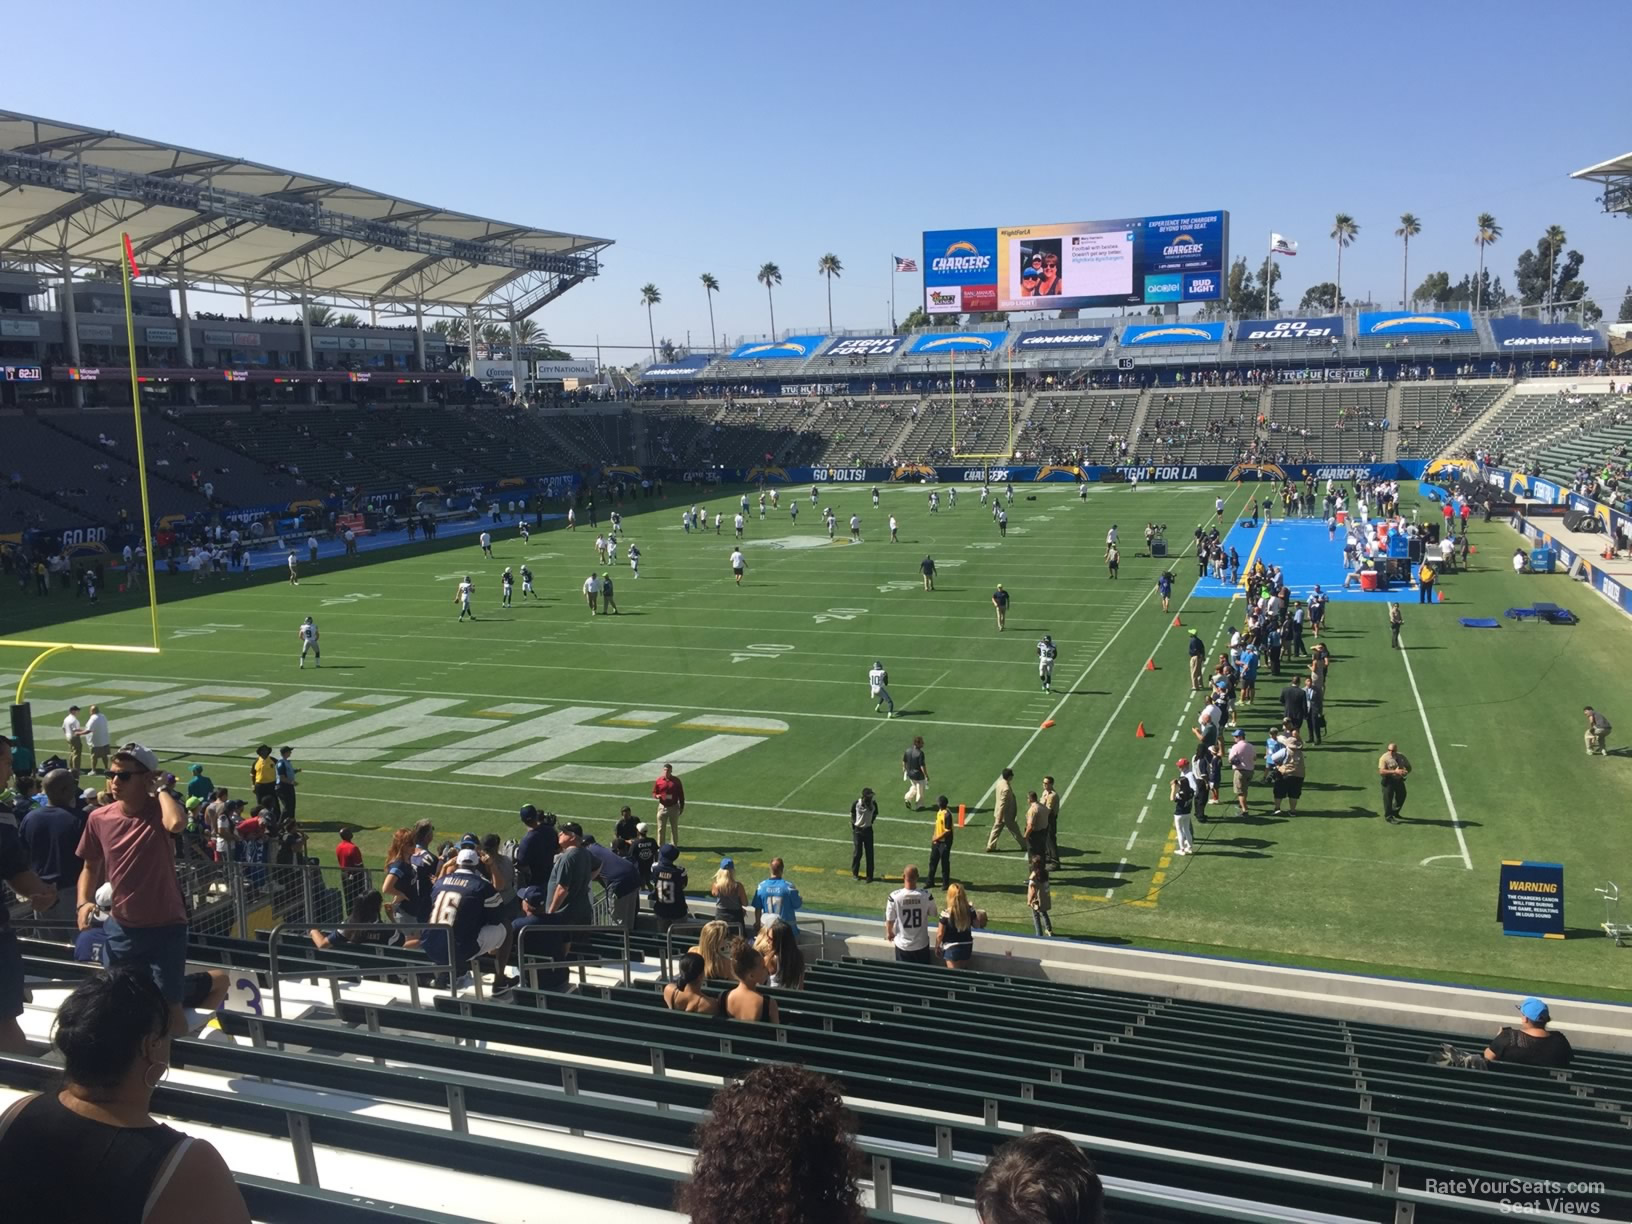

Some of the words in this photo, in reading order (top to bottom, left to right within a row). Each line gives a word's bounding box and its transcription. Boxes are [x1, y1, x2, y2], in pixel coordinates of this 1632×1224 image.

[1163, 243, 1203, 255] CHARGERS
[932, 255, 991, 271] CHARGERS
[1193, 279, 1211, 287] BUD
[1189, 285, 1215, 293] LIGHT
[1274, 321, 1307, 330] GO
[1248, 328, 1331, 339] BOLTS!
[839, 338, 900, 347] FIGHT
[1503, 336, 1594, 346] CHARGERS
[828, 346, 868, 355] FOR
[869, 346, 894, 354] LA
[539, 365, 553, 373] CITY
[554, 365, 590, 373] NATIONAL
[1122, 359, 1132, 368] 16
[1329, 370, 1366, 378] CETER
[813, 469, 827, 481] GO
[1155, 467, 1179, 479] FOR
[1182, 467, 1197, 479] LA
[1316, 468, 1370, 479] CHARGRS
[63, 530, 83, 545] GO
[305, 630, 312, 638] 9
[730, 643, 796, 659] 10
[1042, 650, 1052, 658] 36
[872, 675, 880, 685] 10
[443, 877, 469, 888] WILLIAMS
[1509, 881, 1557, 893] WARNING
[656, 880, 675, 904] 13
[429, 890, 462, 927] 16
[767, 896, 782, 915] 17
[903, 908, 922, 928] 28
